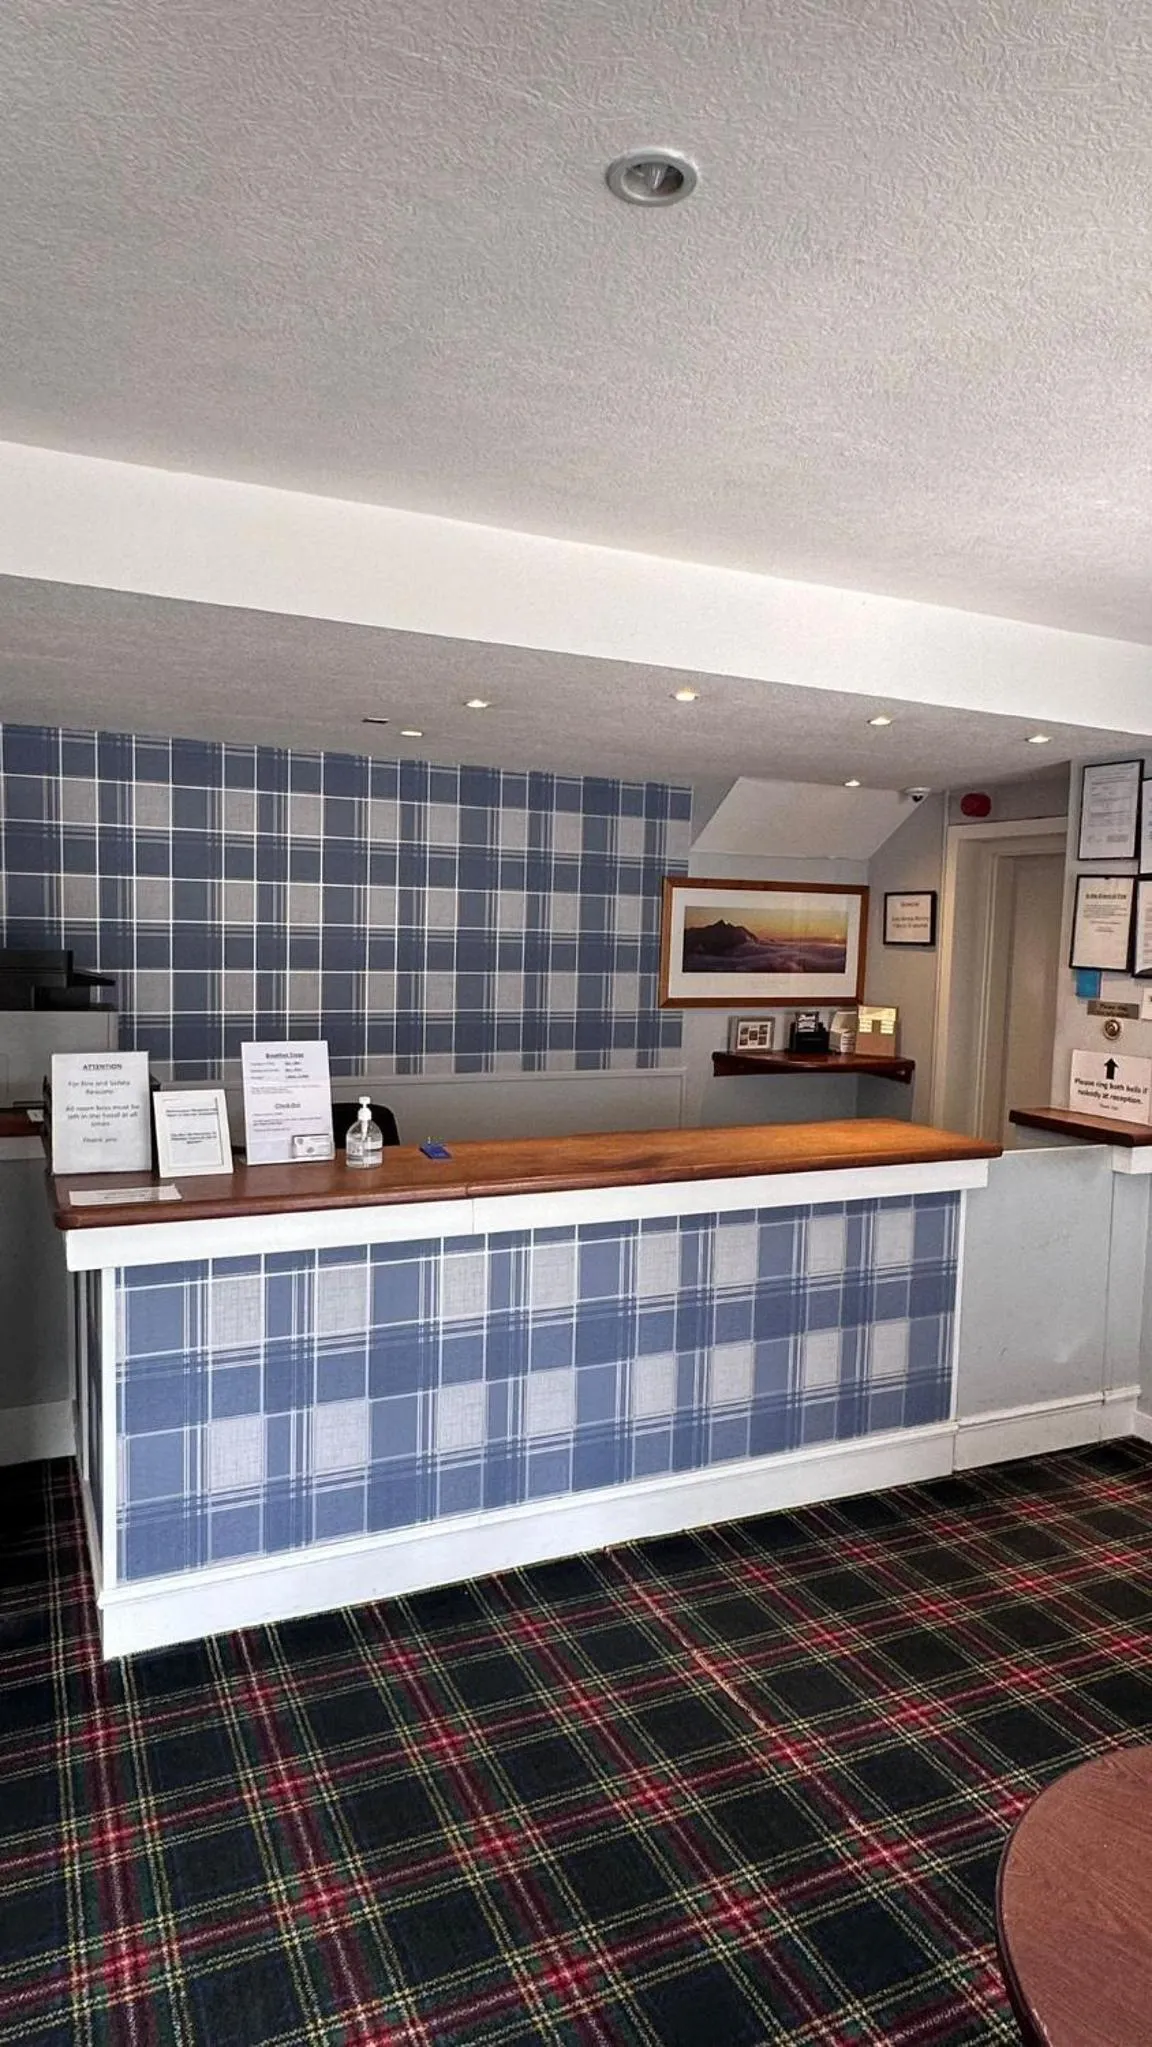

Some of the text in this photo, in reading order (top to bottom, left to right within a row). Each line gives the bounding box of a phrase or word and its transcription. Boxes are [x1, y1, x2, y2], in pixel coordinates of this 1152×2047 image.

[82, 1063, 123, 1071] ATTENTION
[1074, 1078, 1095, 1087] Please
[1096, 1081, 1108, 1090] ring
[1109, 1082, 1124, 1091] both
[1126, 1085, 1141, 1093] bells
[1077, 1089, 1101, 1099] nobody
